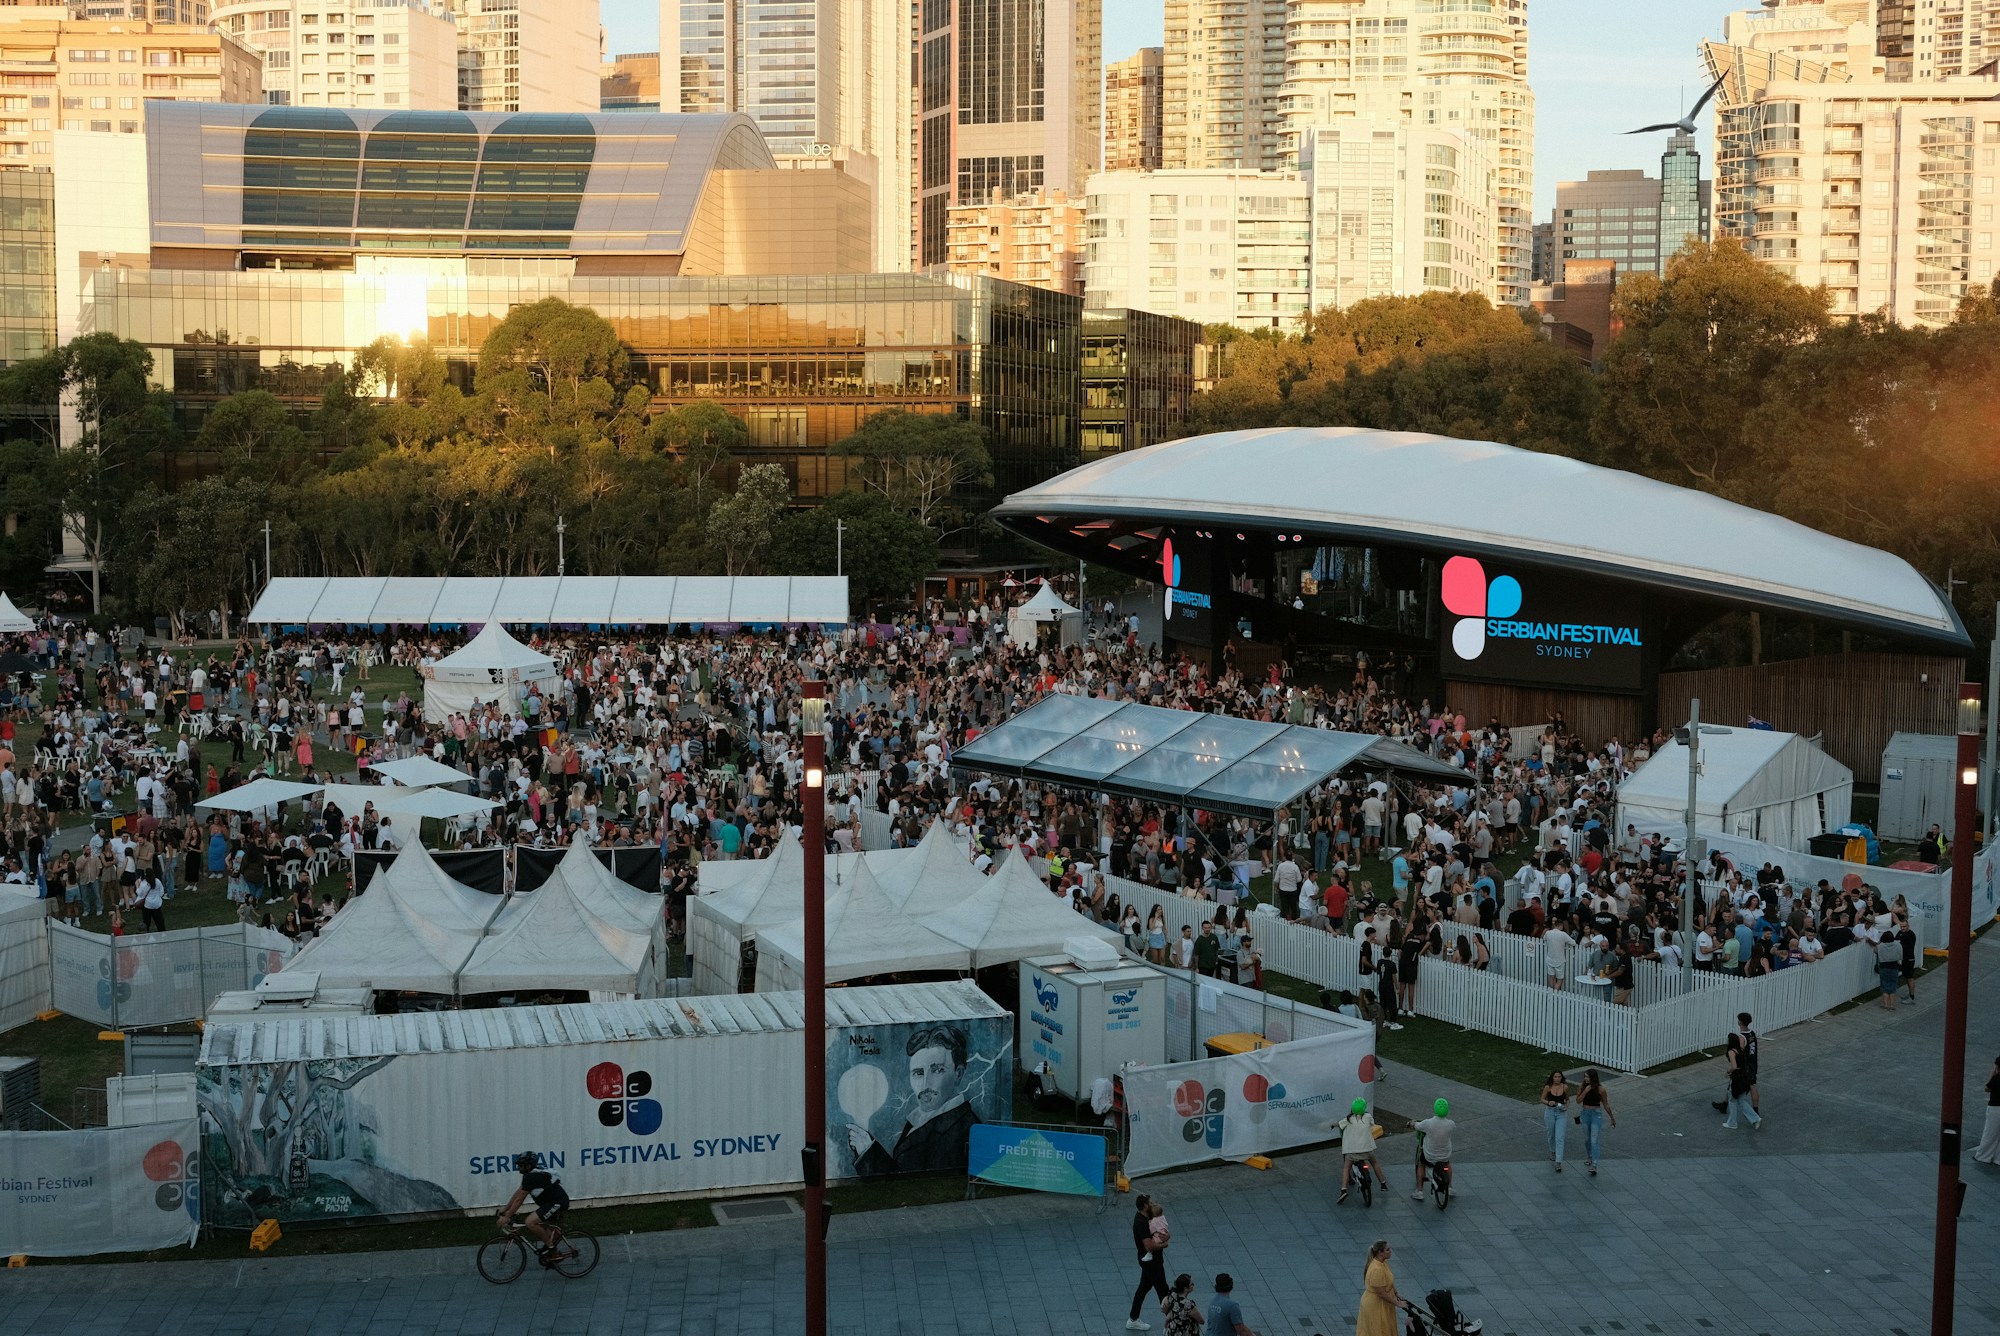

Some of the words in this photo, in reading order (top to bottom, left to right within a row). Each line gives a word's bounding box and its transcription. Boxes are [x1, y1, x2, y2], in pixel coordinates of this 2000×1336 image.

[1745, 16, 1826, 32] WALDORF
[800, 139, 832, 156] vibe
[1189, 592, 1211, 608] FESTIVAL
[1486, 619, 1558, 640] SERBIAN
[1560, 624, 1642, 646] FESTIVAL
[1536, 644, 1592, 659] SYDNEY
[850, 1035, 875, 1045] Nikola
[859, 1046, 880, 1055] Tesla
[1268, 1100, 1302, 1110] SERBIAN
[1302, 1092, 1335, 1107] FESTIVAL
[470, 1151, 565, 1174] SERBAN
[580, 1143, 680, 1166] FESTIVAL
[693, 1134, 781, 1158] SYDNEY
[998, 1144, 1028, 1156] FRED
[1031, 1148, 1052, 1159] THE
[1056, 1151, 1074, 1160] FIG
[37, 1176, 93, 1190] Festival
[18, 1194, 57, 1204] SYDNEY
